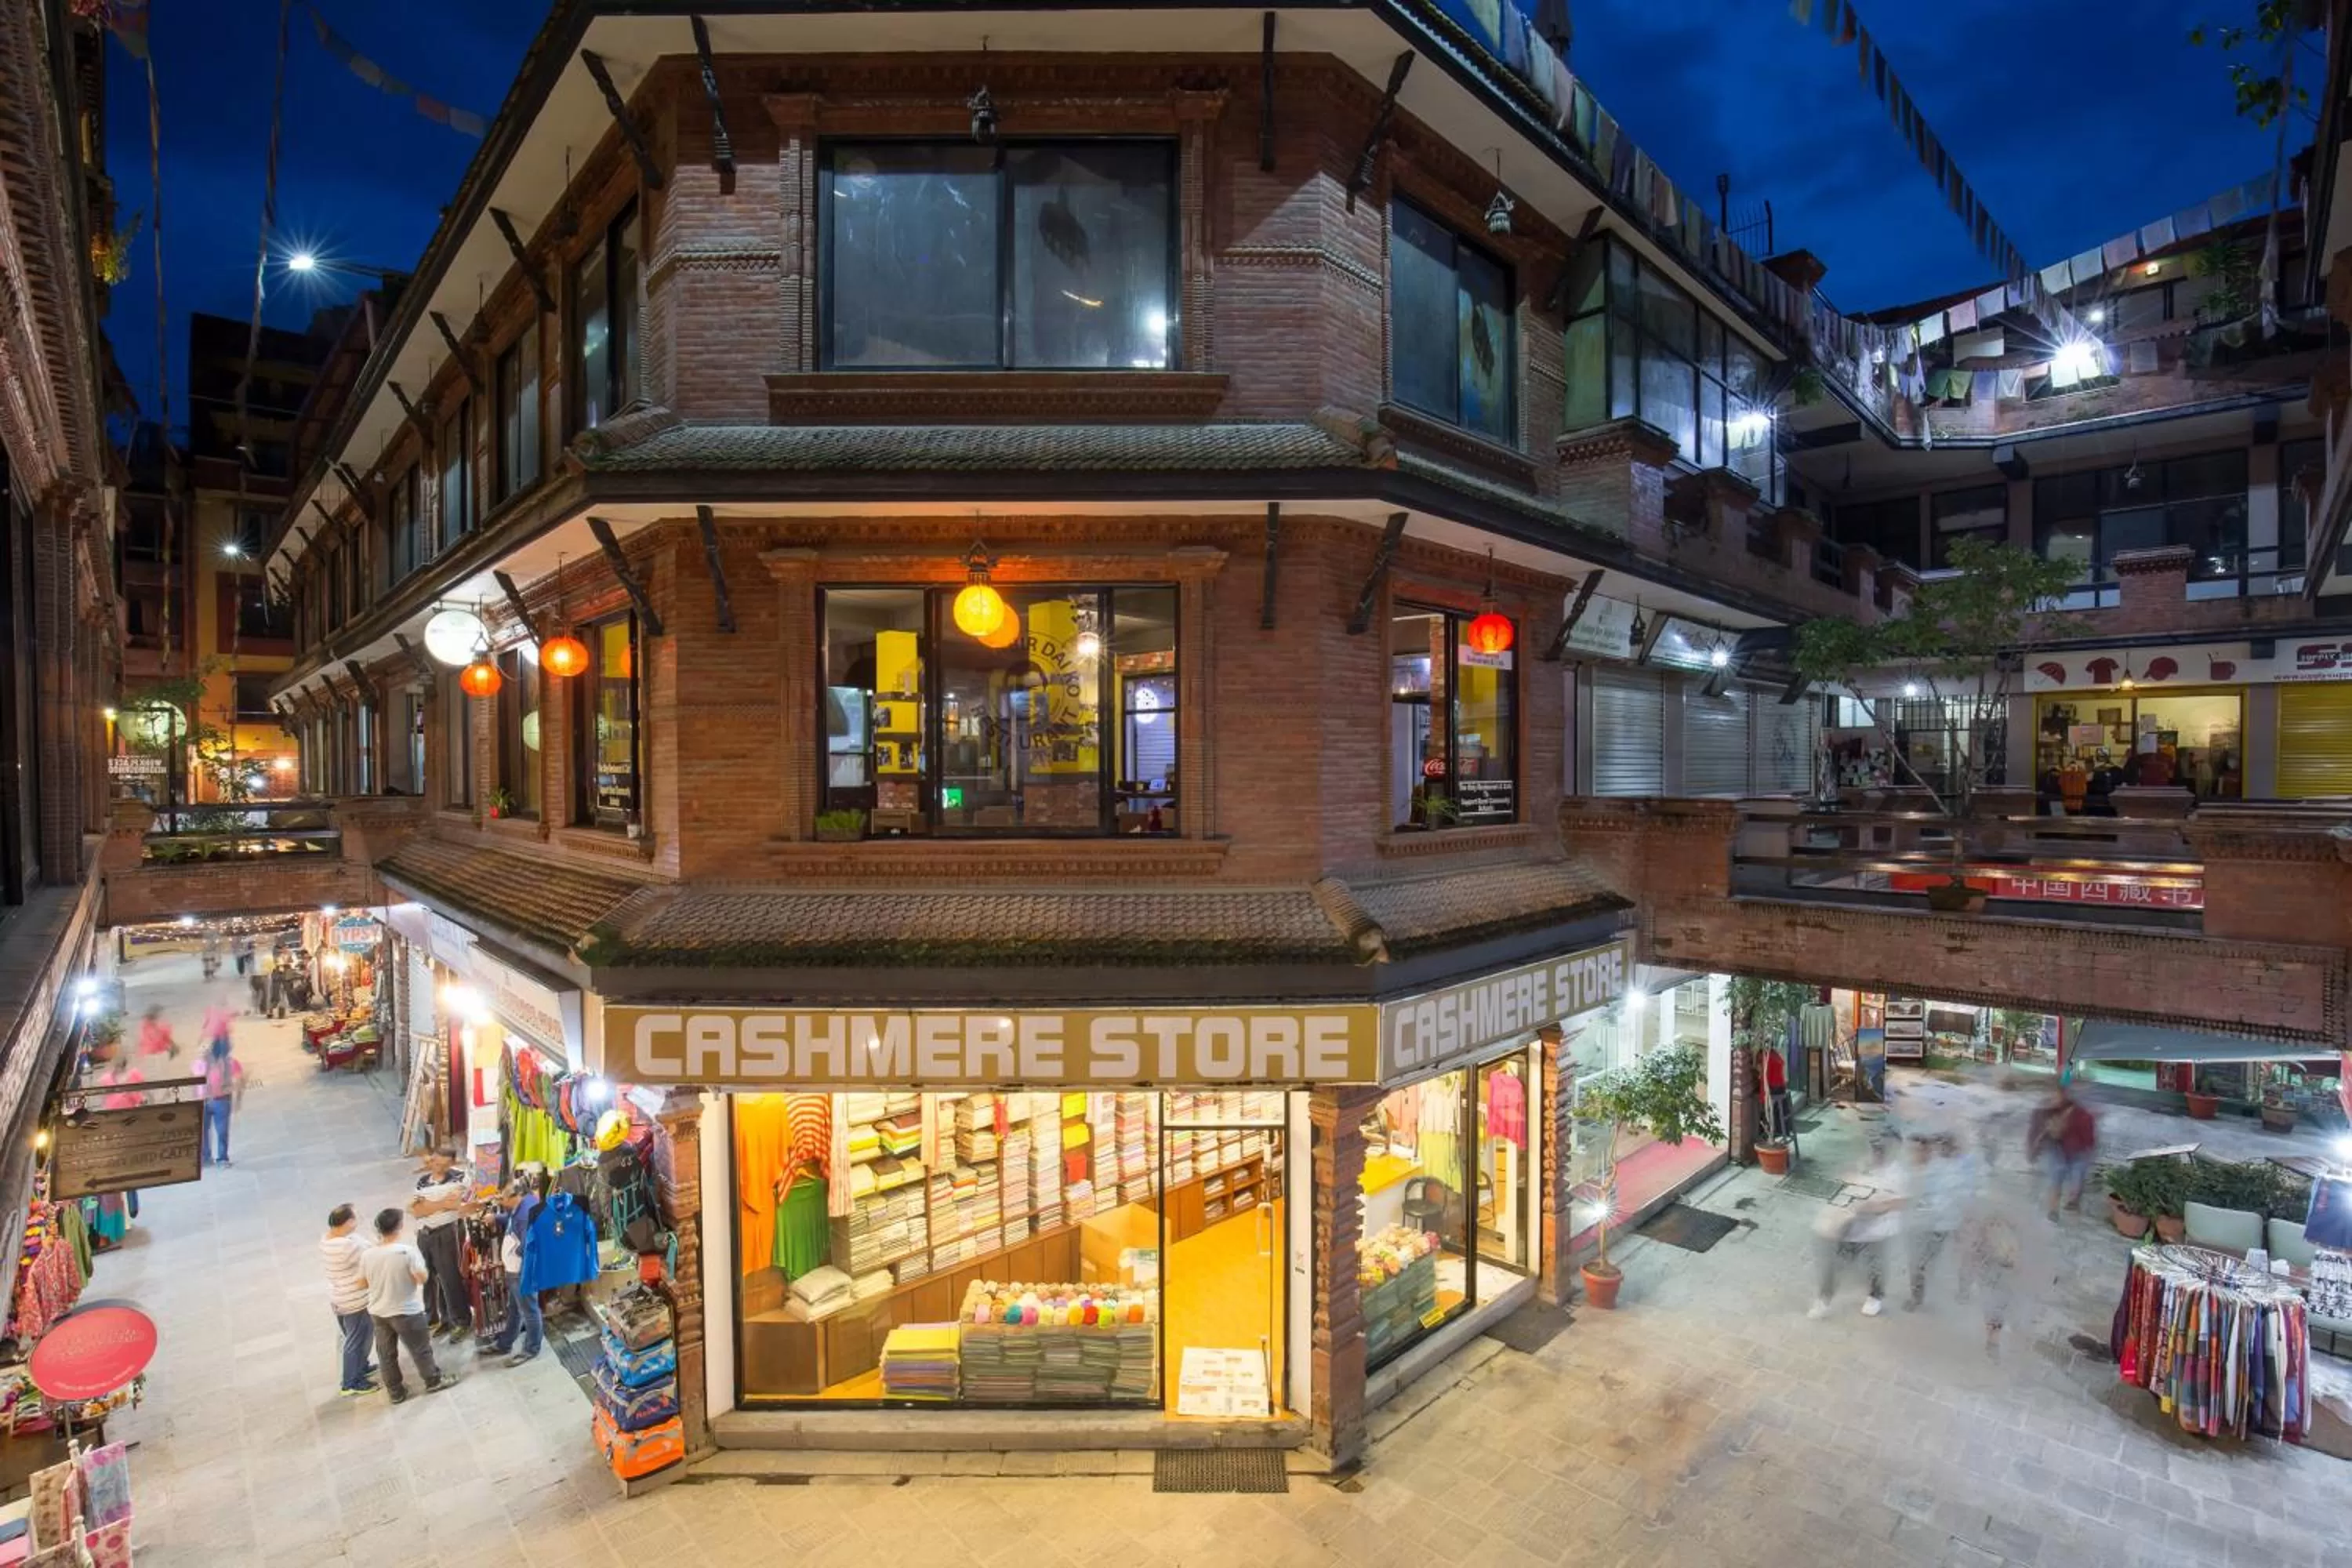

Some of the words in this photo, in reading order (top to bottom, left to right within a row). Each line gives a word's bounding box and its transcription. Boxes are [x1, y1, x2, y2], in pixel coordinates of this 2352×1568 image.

[2012, 877, 2204, 905] 中国西藏书
[1394, 970, 1548, 1069] CASHMERE
[1555, 949, 1623, 1016] STORE
[634, 1014, 1064, 1077] CASHMERE
[1089, 1015, 1349, 1078] STORE
